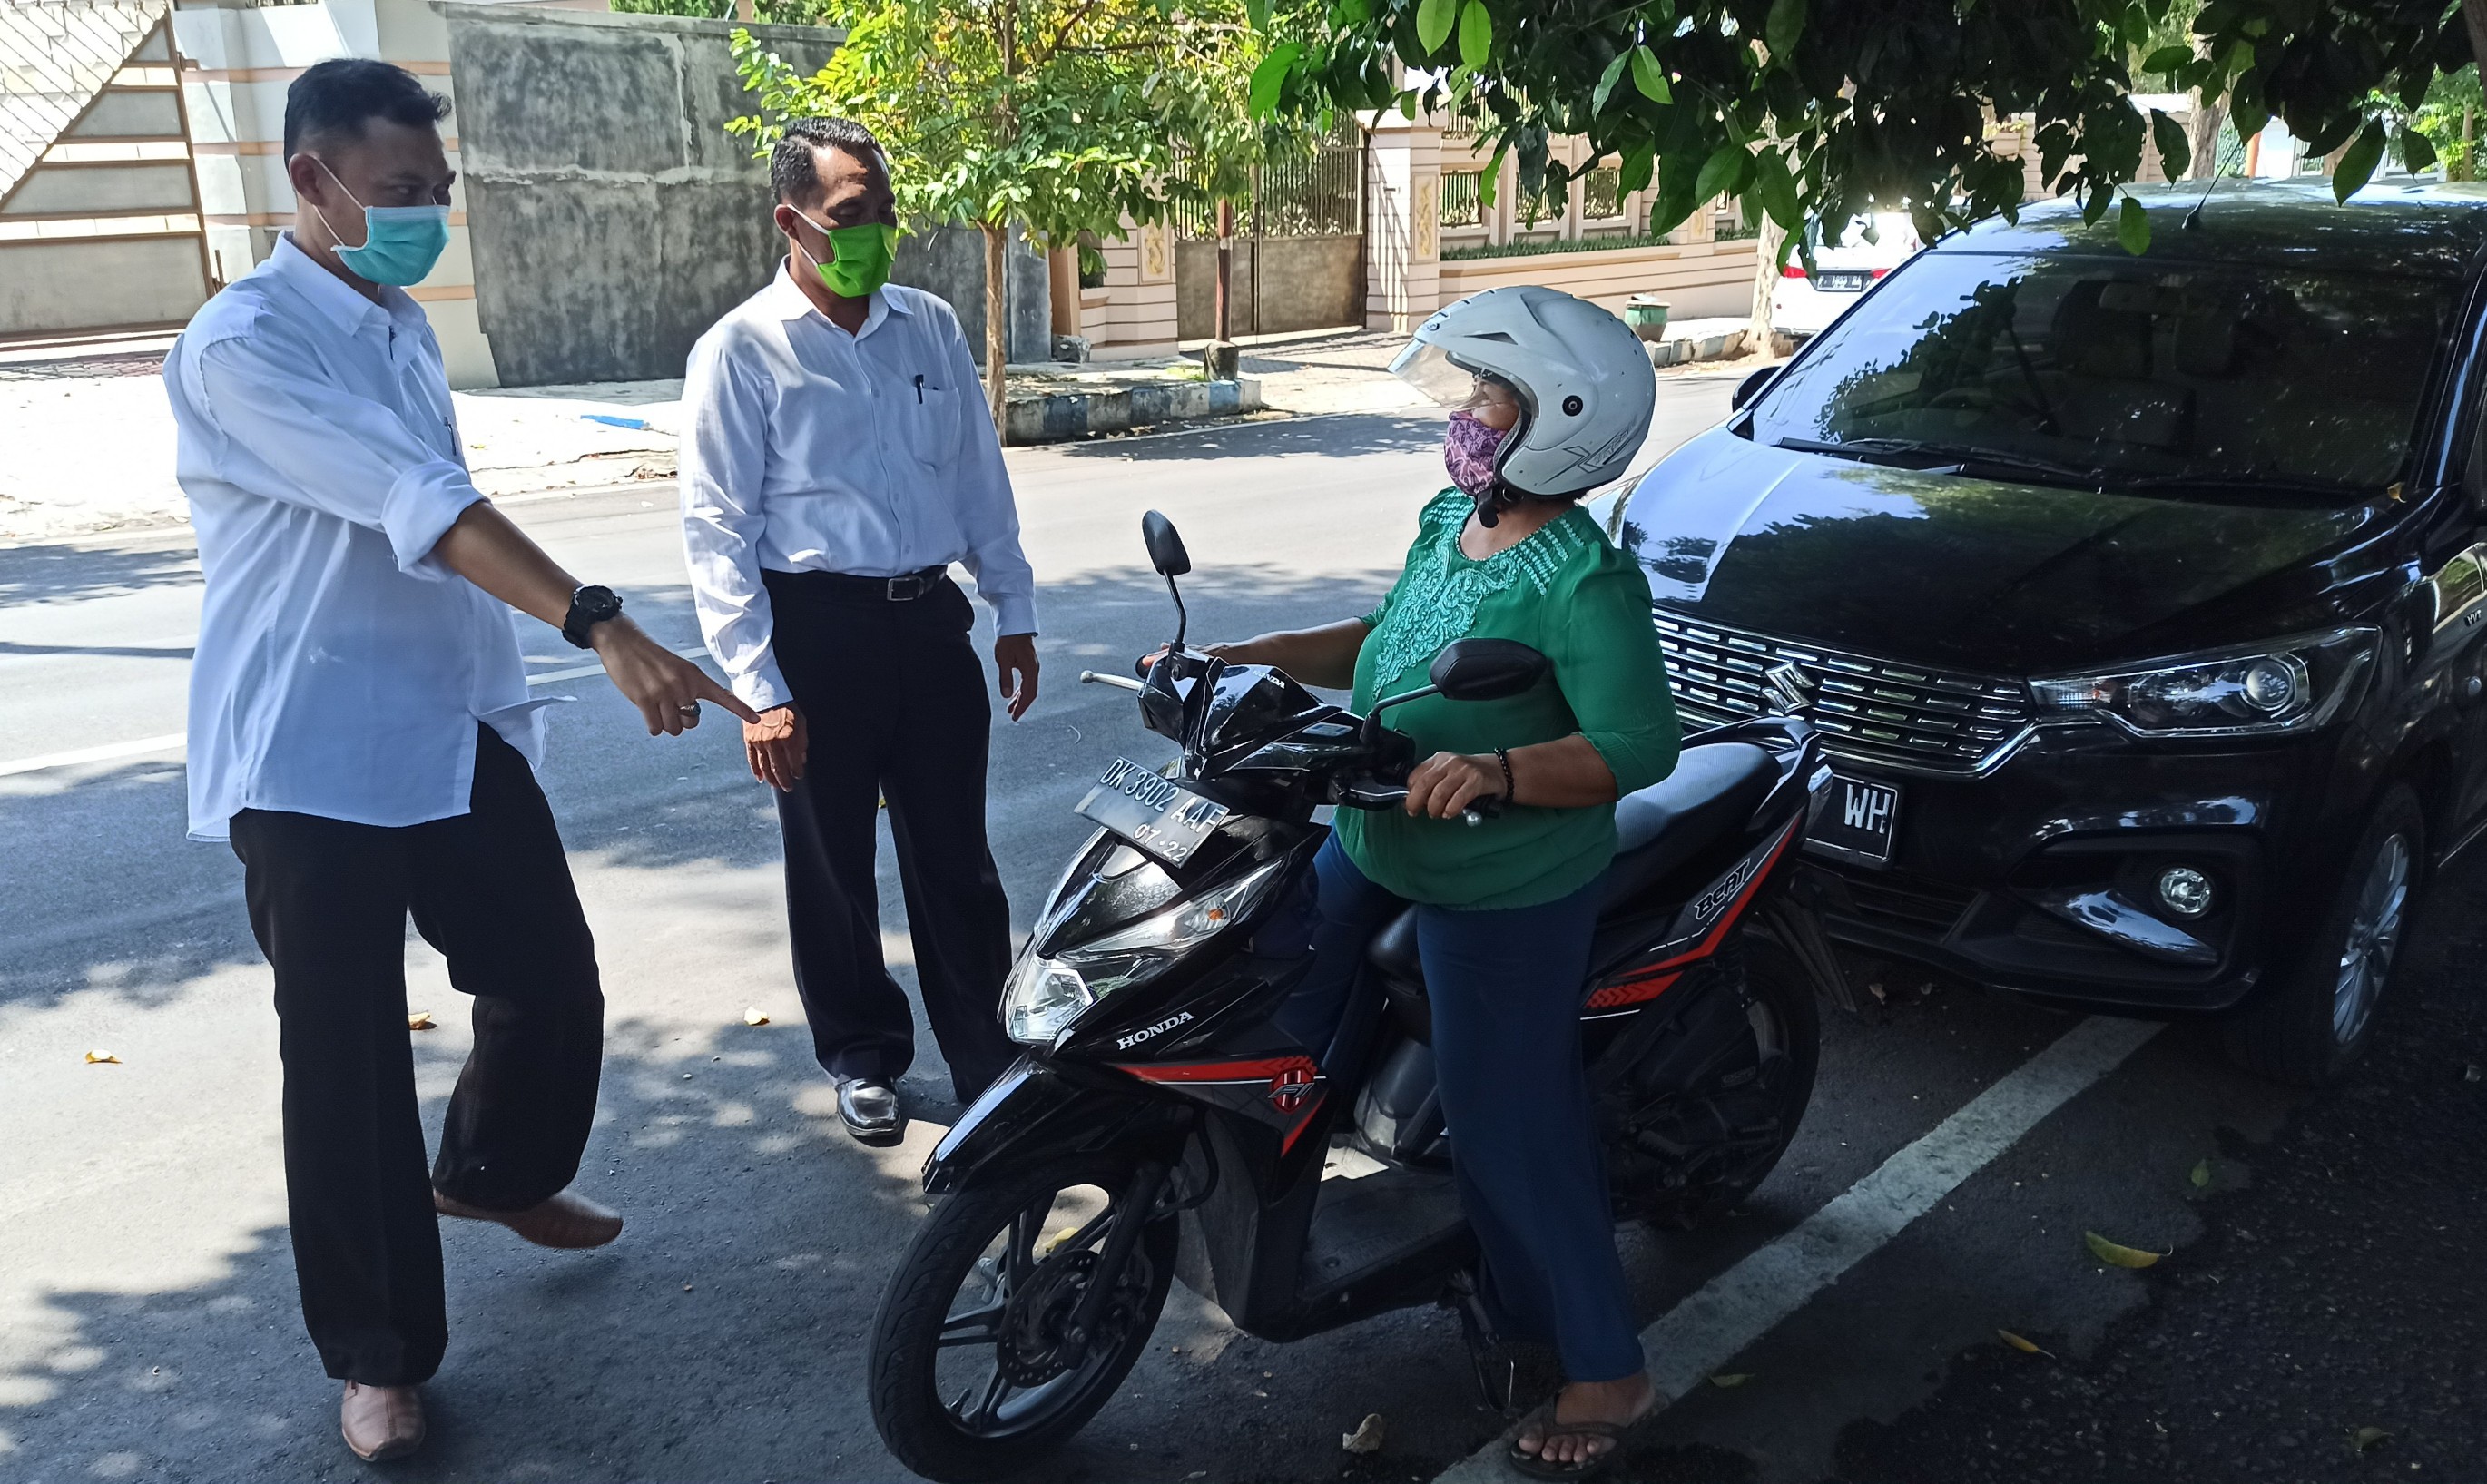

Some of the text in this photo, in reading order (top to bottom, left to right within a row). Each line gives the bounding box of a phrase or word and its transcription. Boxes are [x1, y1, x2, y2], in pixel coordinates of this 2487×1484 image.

[1099, 759, 1225, 834] DK 3902 AAF
[1843, 783, 1892, 834] WH
[1116, 1010, 1195, 1050] HONDA
[1267, 1082, 1315, 1099] FI
